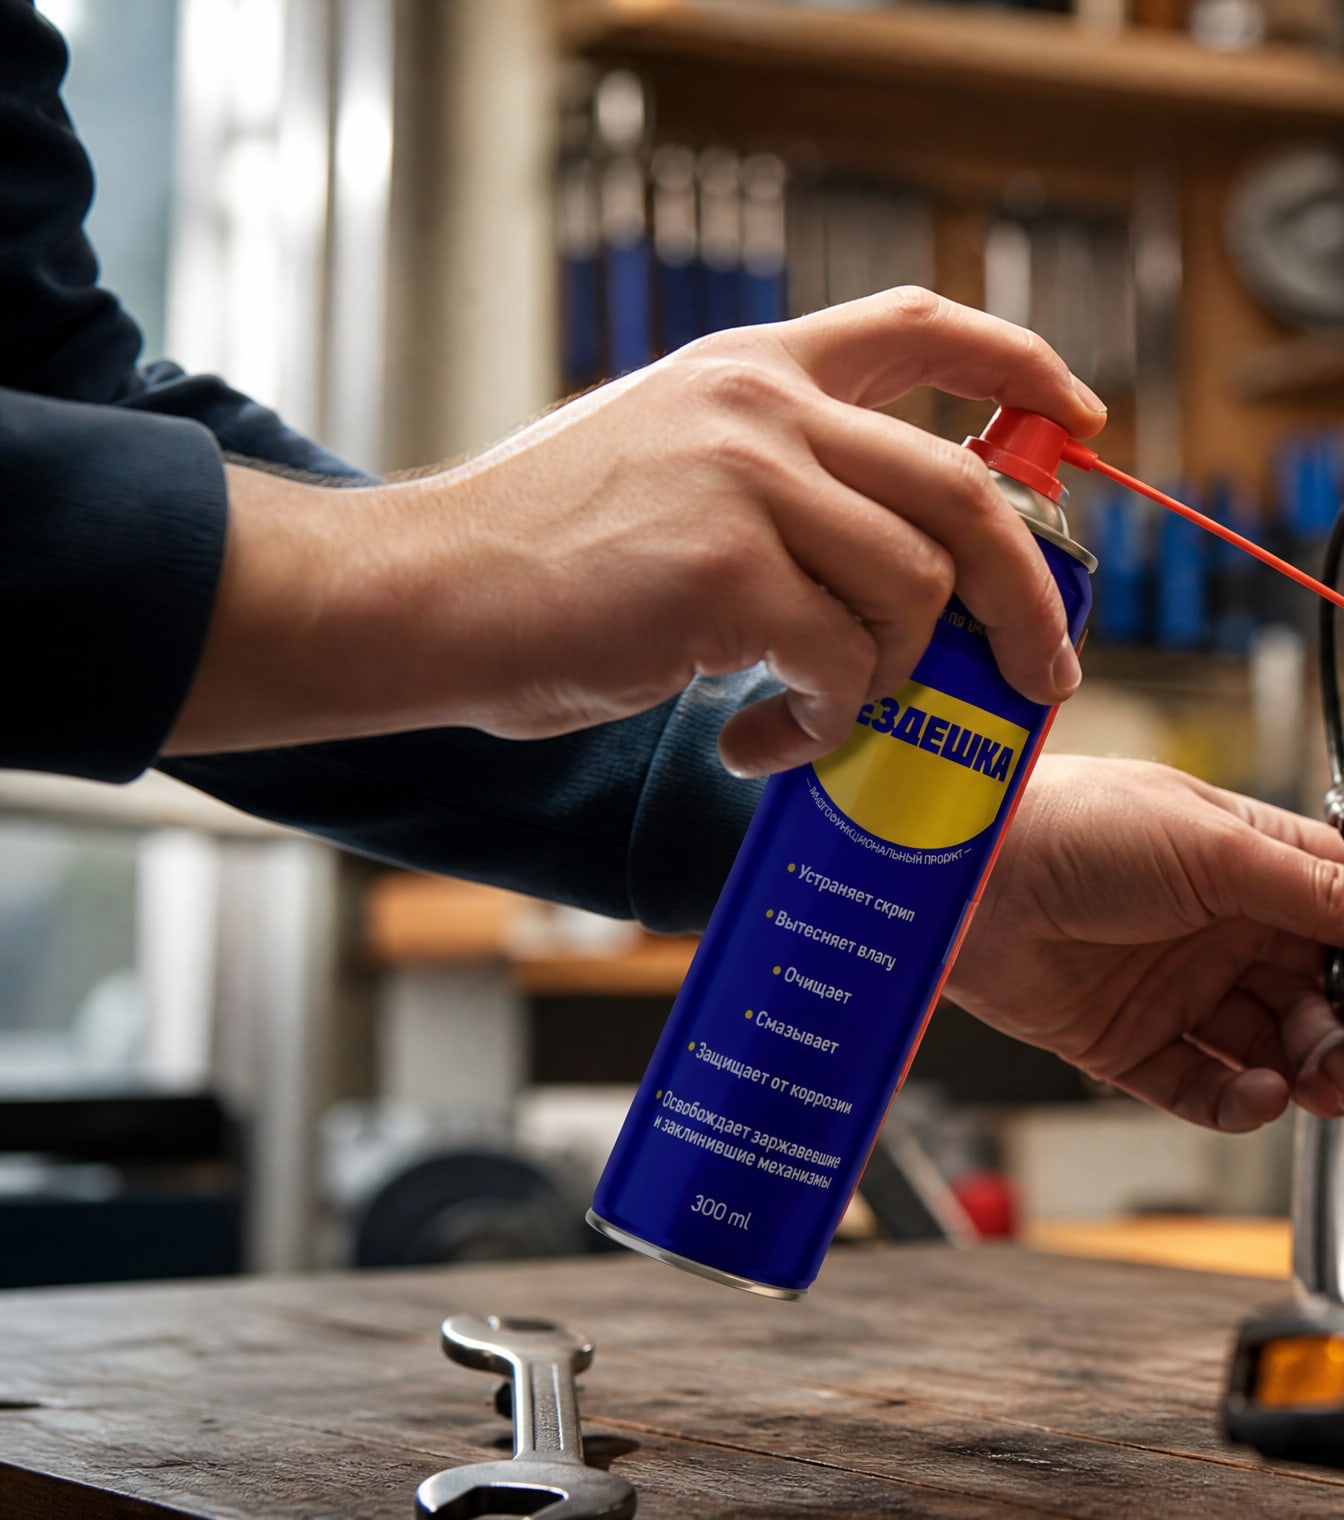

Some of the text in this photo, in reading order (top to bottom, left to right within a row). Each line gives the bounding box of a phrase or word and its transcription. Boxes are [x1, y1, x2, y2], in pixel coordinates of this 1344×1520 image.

[856, 697, 1014, 782] ЕЗДЕШКА
[798, 864, 915, 922] Устраняет скрип
[774, 910, 896, 972] Вытесняет влагу
[784, 967, 852, 1004] Очищает
[755, 1010, 839, 1055] Смазывает
[695, 1042, 853, 1115] Защищает от коррозии
[653, 1115, 832, 1189] и заклинившие механизмы
[662, 1090, 841, 1169] Освобождает заржавевшие
[690, 1195, 752, 1230] 300 ml
